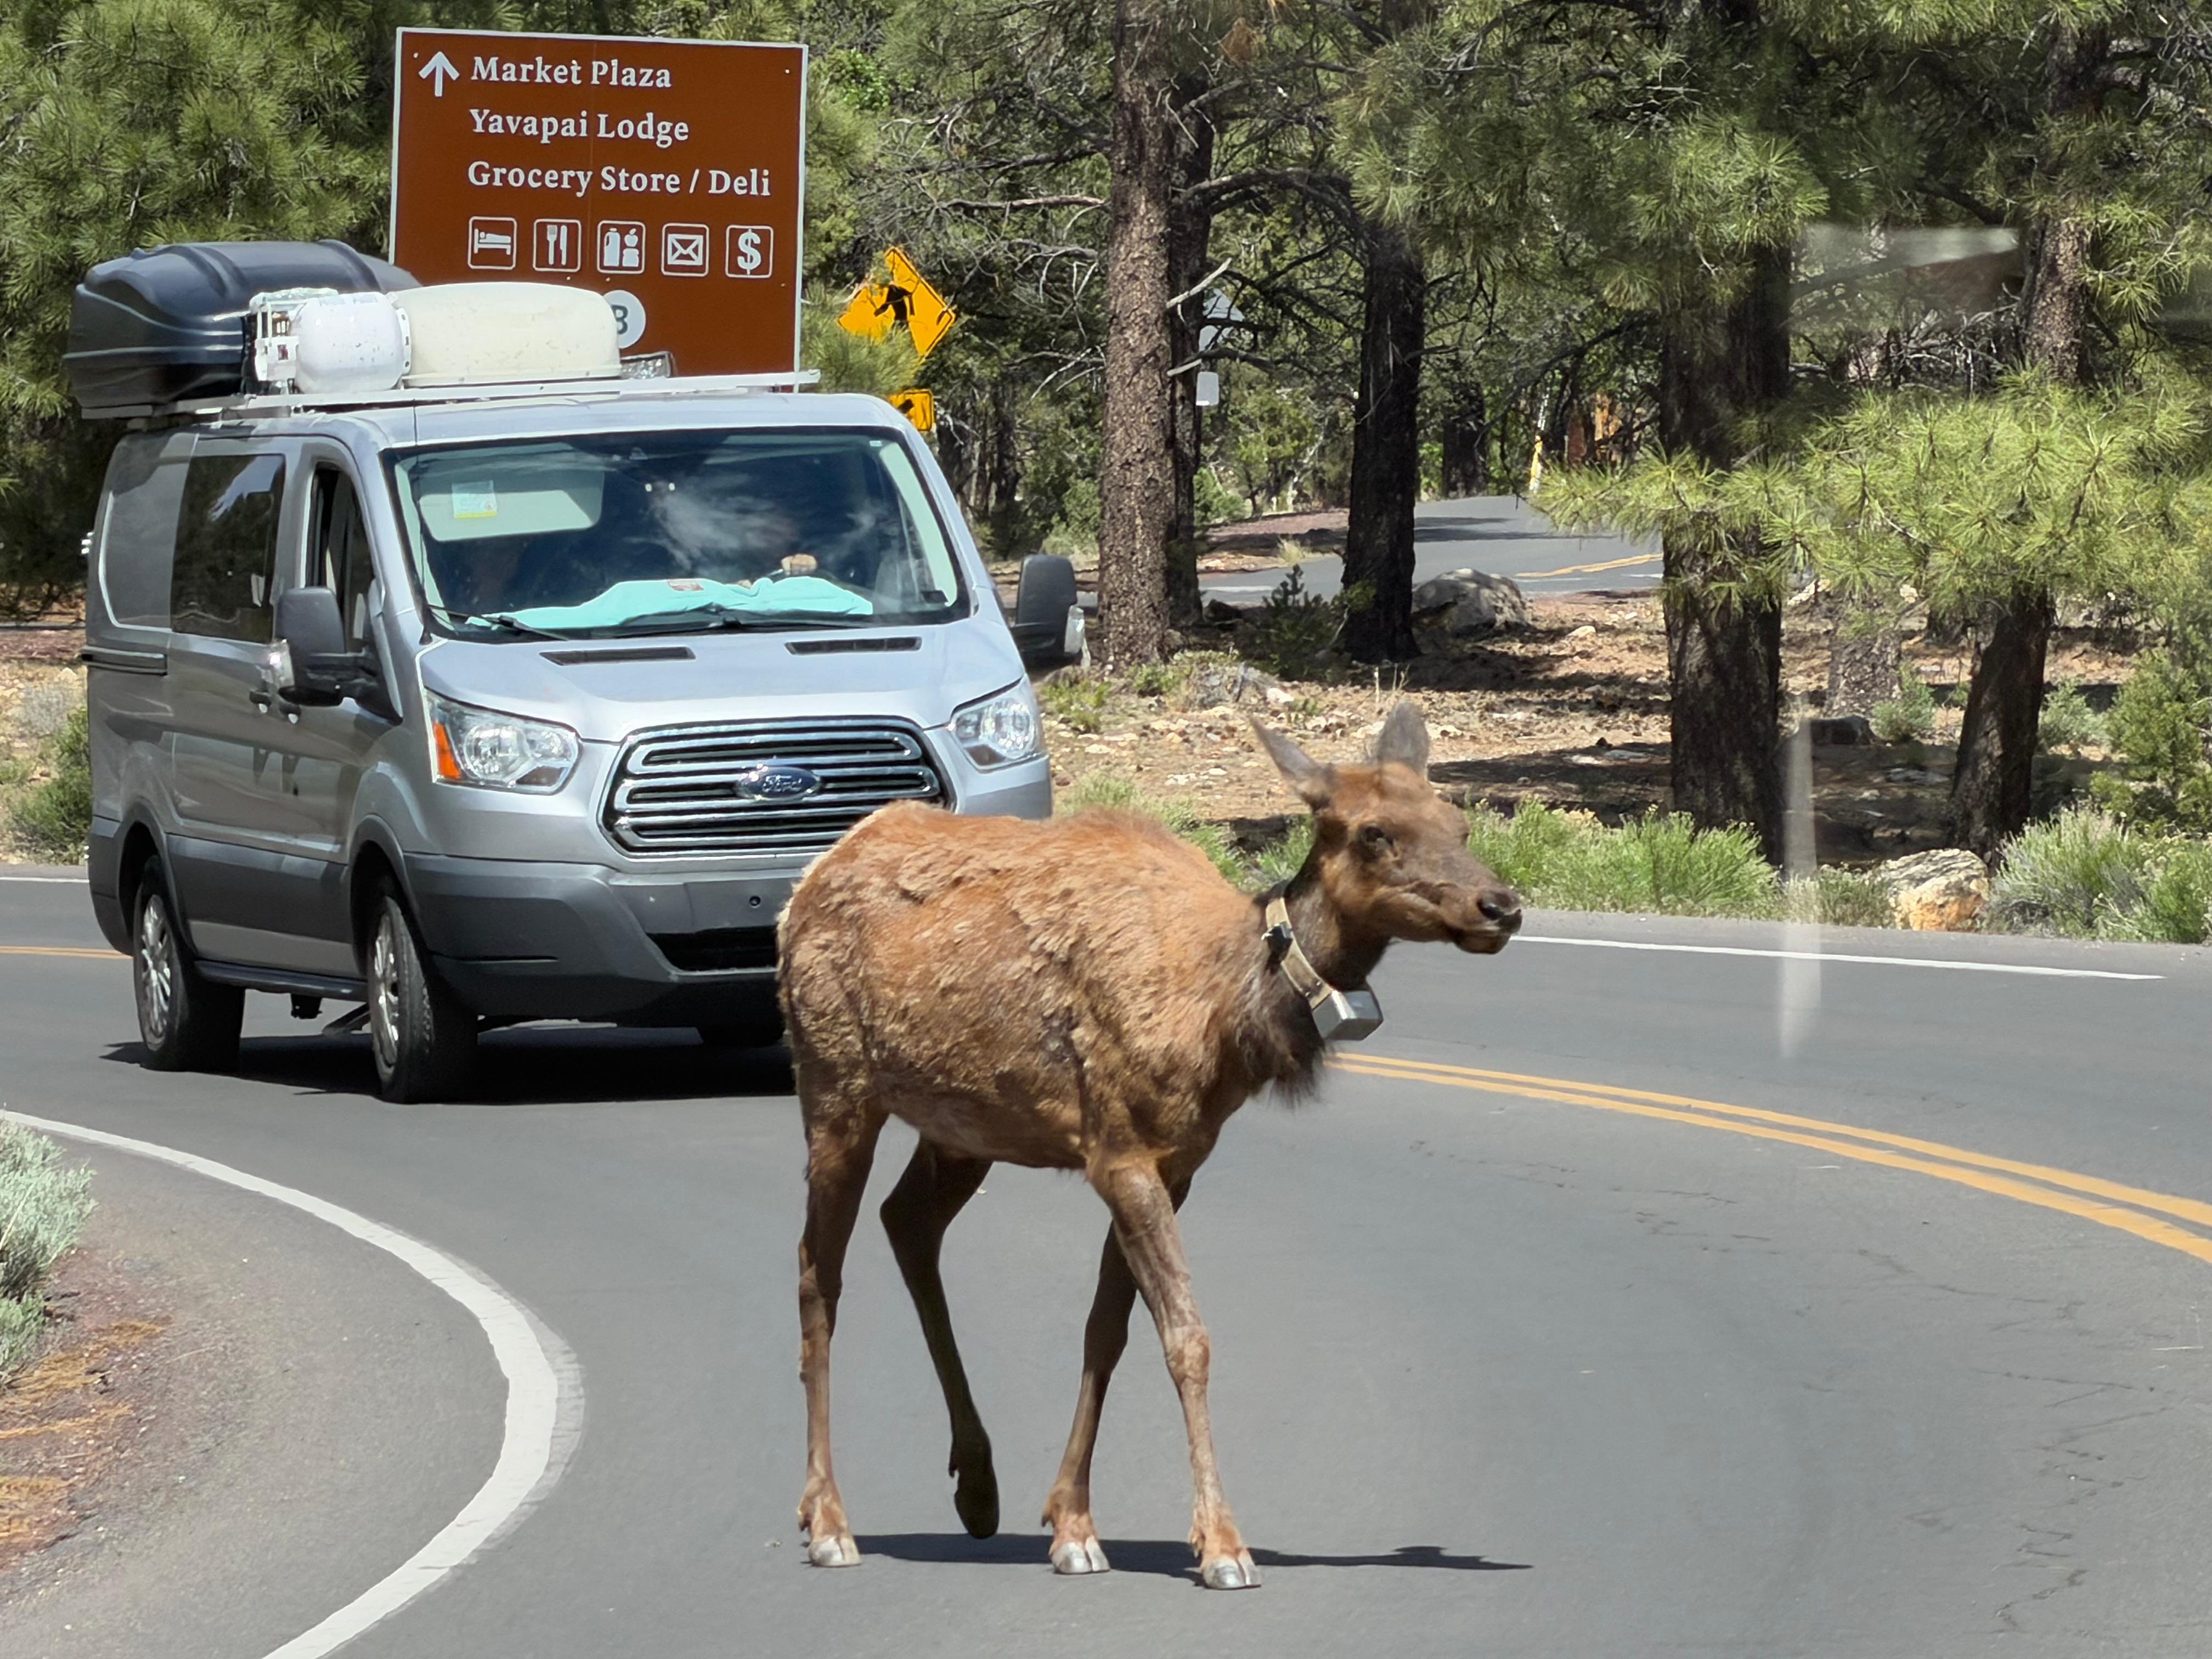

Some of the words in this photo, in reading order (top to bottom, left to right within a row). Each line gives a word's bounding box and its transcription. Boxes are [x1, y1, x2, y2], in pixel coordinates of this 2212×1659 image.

[470, 56, 582, 85] Market
[590, 59, 672, 88] Plaza
[469, 109, 588, 144] Yavapai
[597, 112, 689, 149] Lodge
[468, 161, 593, 198] Grocery
[601, 166, 680, 194] Store
[689, 168, 699, 194] /
[708, 168, 771, 196] Deli
[761, 774, 803, 793] Ford
